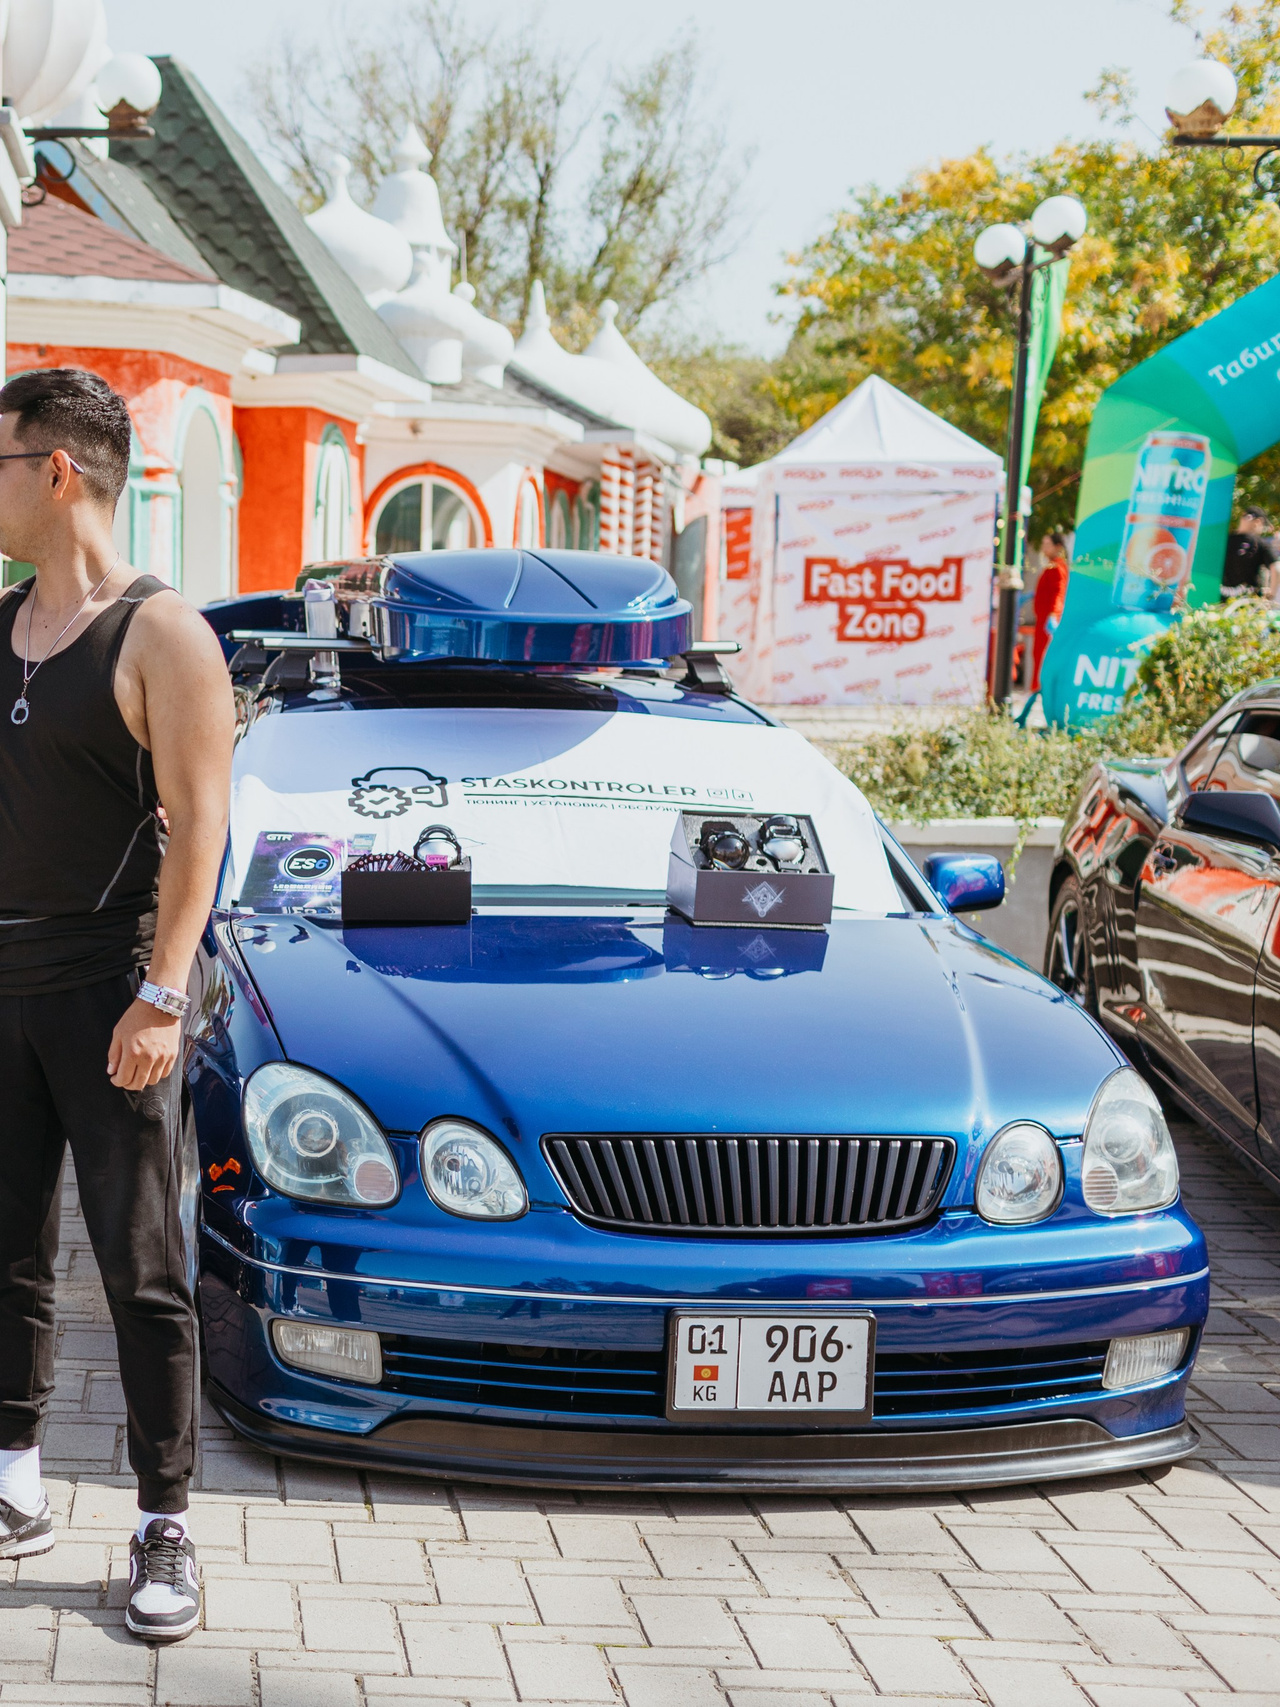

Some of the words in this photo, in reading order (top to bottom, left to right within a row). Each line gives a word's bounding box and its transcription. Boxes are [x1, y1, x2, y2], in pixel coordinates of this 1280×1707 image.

[1135, 463, 1208, 494] NITRO
[810, 563, 876, 599] Fast
[881, 563, 958, 598] Food
[843, 603, 921, 638] Zone
[1073, 654, 1141, 691] NIT
[1077, 692, 1124, 713] FRES
[461, 777, 697, 797] STASKONTROLER
[530, 800, 608, 808] УСТАНОВКА
[266, 833, 293, 841] GTR
[289, 857, 329, 870] ES6
[688, 1324, 728, 1354] 01
[765, 1325, 844, 1363] 906
[693, 1385, 717, 1402] KG
[767, 1371, 838, 1403] AAP
